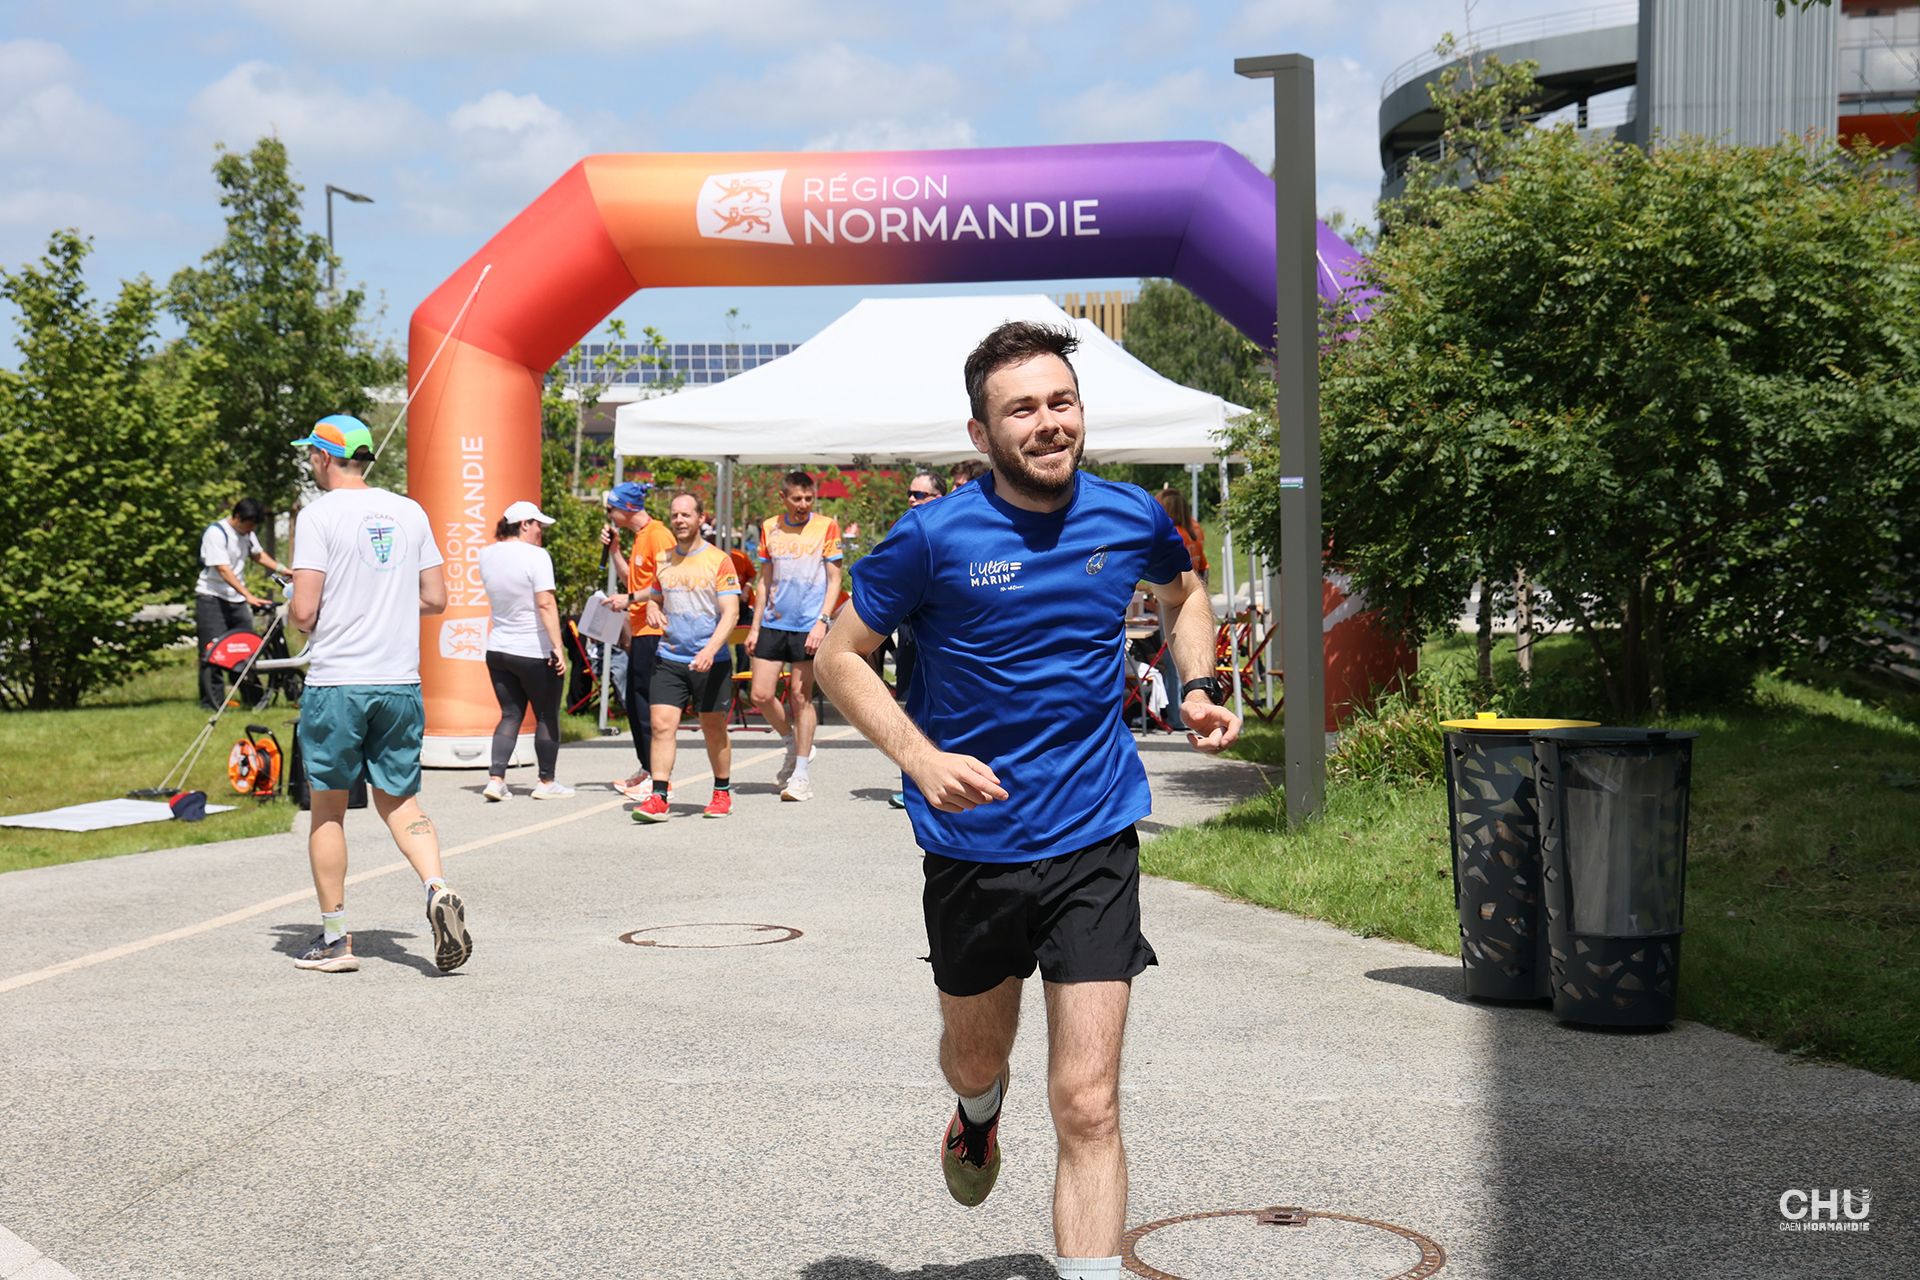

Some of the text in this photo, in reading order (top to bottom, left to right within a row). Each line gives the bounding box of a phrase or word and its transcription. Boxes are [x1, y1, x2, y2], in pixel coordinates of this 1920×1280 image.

[803, 172, 948, 203] RÉGION
[803, 199, 1100, 244] NORMANDIE
[446, 522, 465, 606] RÉGION
[970, 574, 1011, 587] MARIN
